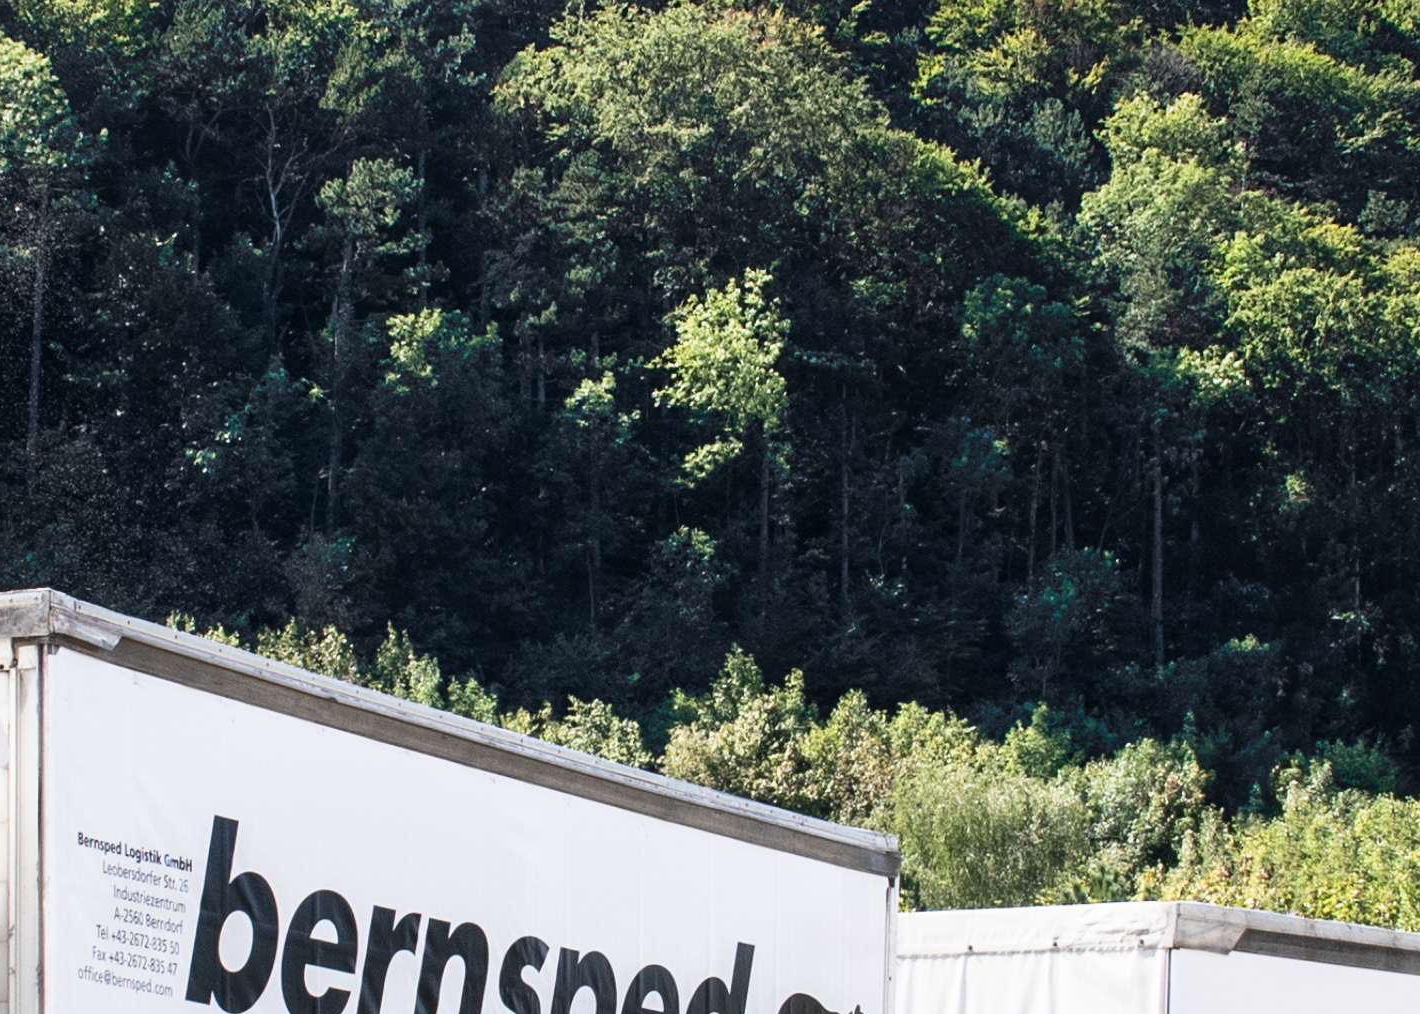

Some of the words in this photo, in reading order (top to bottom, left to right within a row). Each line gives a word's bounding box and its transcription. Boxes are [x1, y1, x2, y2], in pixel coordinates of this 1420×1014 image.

[78, 832, 122, 857] Bernsped
[125, 843, 162, 864] Logistik
[164, 853, 193, 872] GmbH
[102, 860, 161, 887] Leobersdorfer
[164, 874, 177, 891] Str.
[179, 878, 189, 893] 26
[113, 884, 186, 914] Industriezentrum
[114, 907, 144, 926] A-2560
[146, 913, 184, 935] Berndorf
[96, 924, 109, 940] Tel
[111, 930, 167, 953] +43-2672-835
[170, 941, 180, 955] 50
[92, 946, 106, 962] Fax
[109, 951, 165, 974] +43-2672-835
[167, 962, 178, 976] 47
[78, 965, 173, 997] office@bernsped.com
